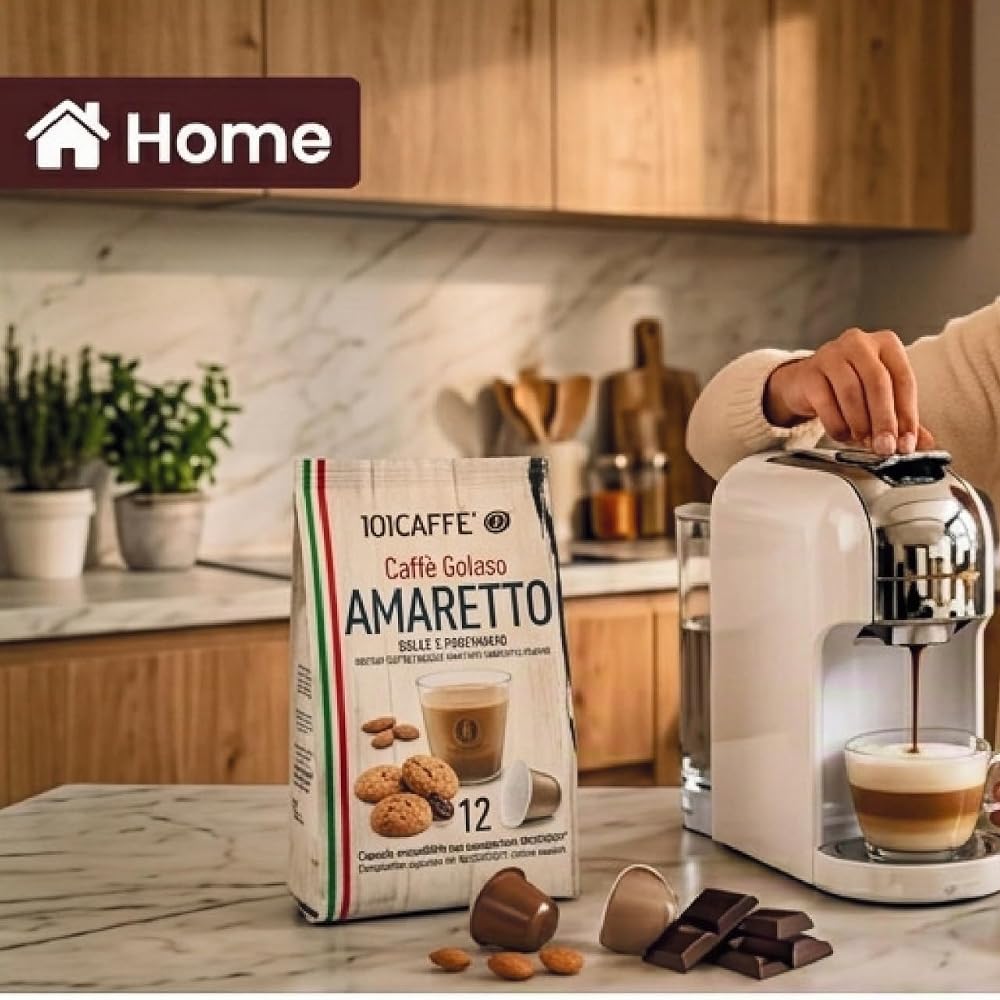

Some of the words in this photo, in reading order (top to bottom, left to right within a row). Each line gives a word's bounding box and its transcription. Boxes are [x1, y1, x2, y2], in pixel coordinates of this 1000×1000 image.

[384, 554, 437, 580] Caffè
[442, 553, 507, 578] Golaso
[345, 579, 552, 635] AMARETTO
[458, 796, 492, 833] 12
